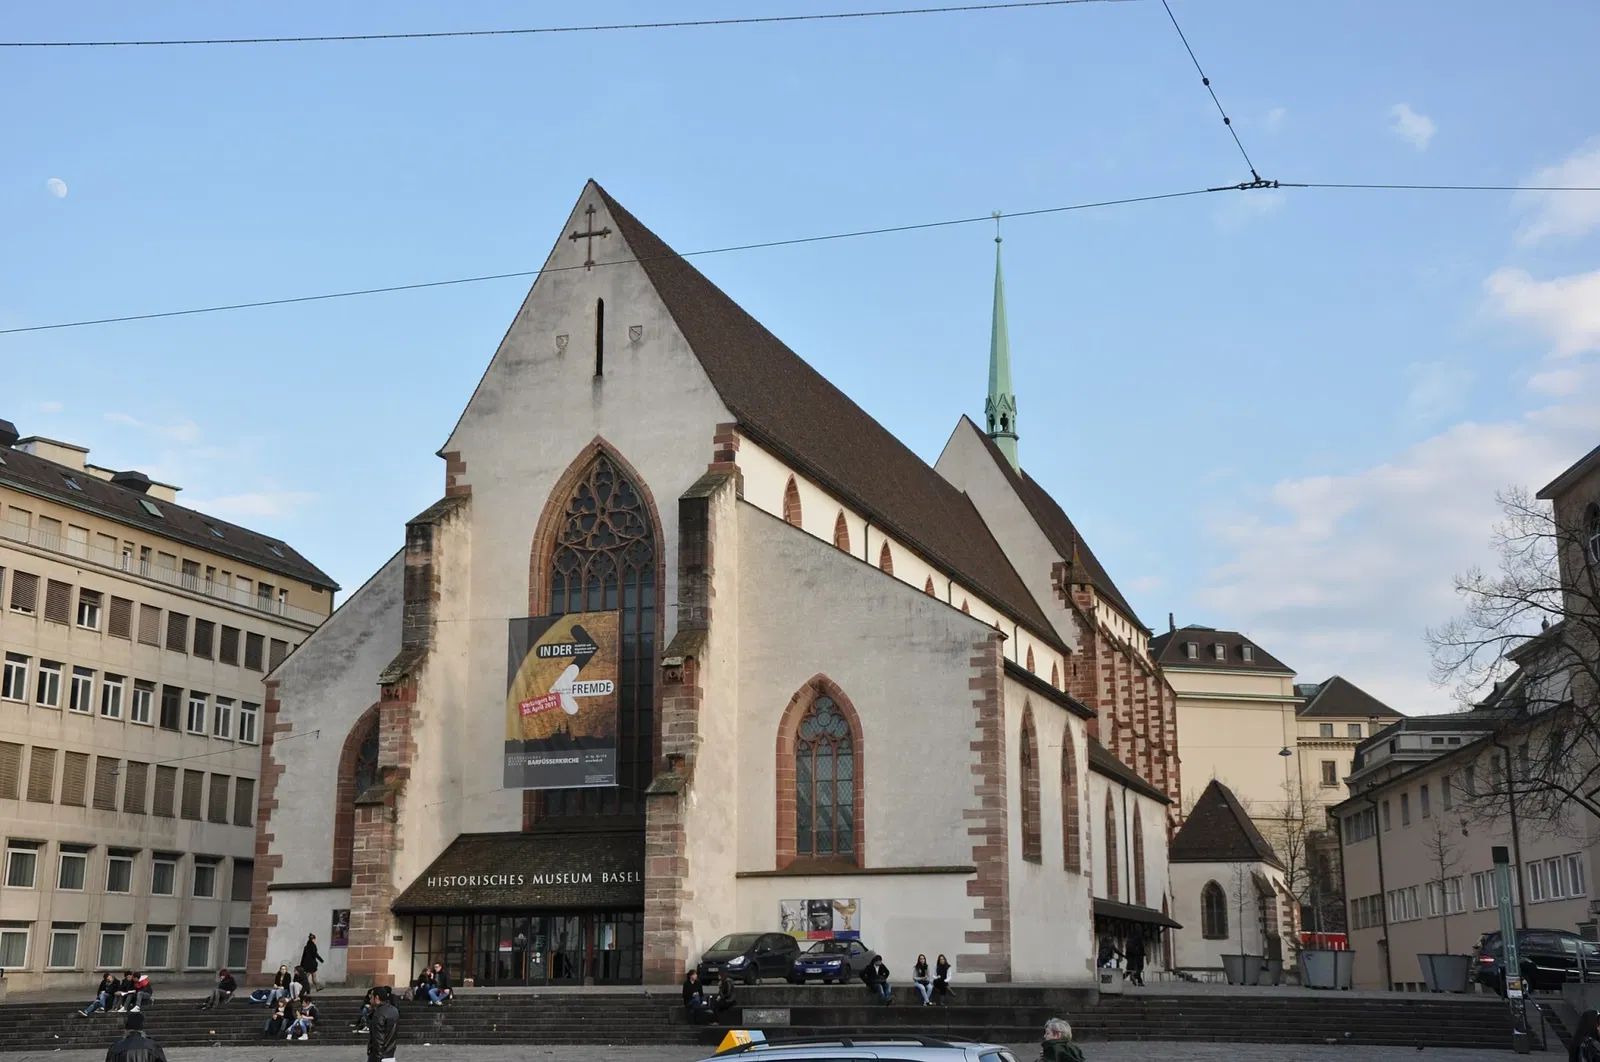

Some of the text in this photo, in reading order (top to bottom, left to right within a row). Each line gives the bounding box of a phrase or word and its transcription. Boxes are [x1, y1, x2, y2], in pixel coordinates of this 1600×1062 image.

[540, 646, 551, 657] IN
[552, 645, 572, 656] DER
[572, 682, 611, 694] FREMDE
[532, 704, 544, 713] April
[544, 701, 557, 709] 2011
[527, 757, 580, 766] BARFÜSSERKIRCHE
[427, 871, 641, 887] HISTORISCHES MUSEUM BASEL
